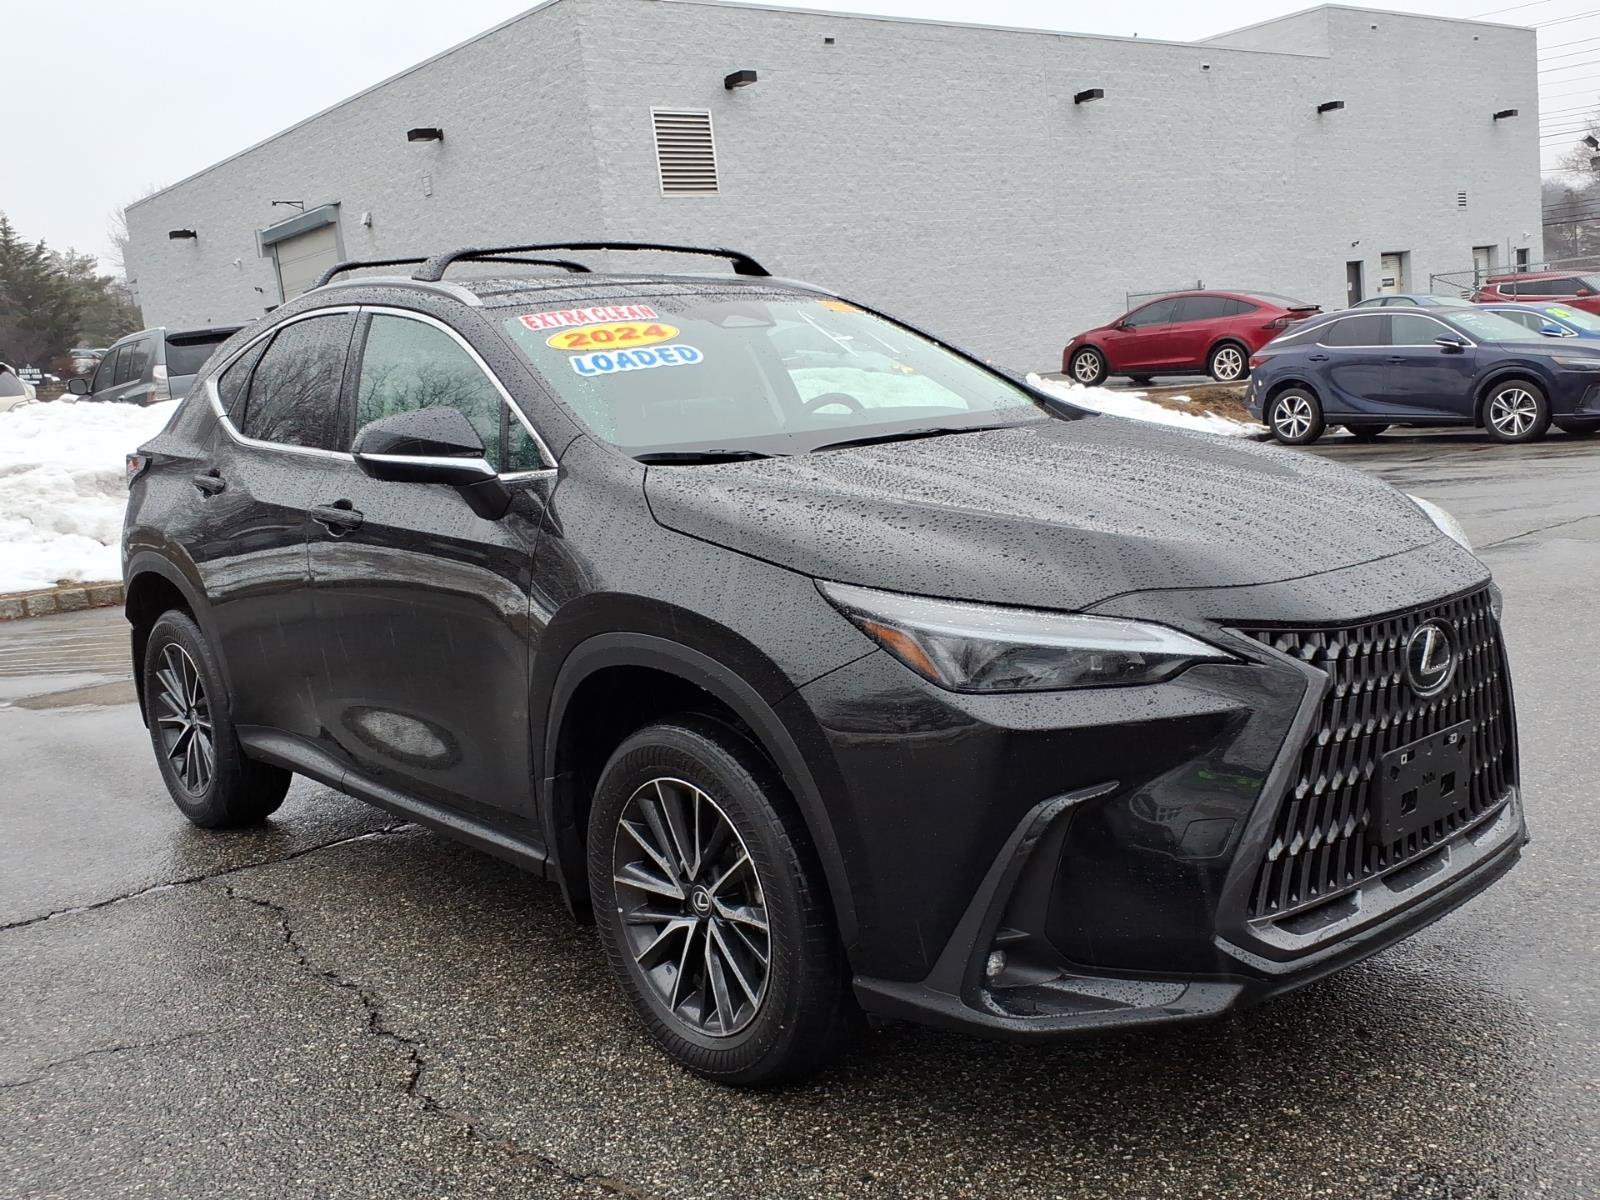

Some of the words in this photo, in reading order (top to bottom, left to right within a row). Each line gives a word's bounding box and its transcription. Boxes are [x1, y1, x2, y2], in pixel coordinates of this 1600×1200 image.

[521, 309, 593, 329] EXTRA
[591, 305, 657, 321] CLEAN
[564, 324, 669, 348] 2024
[573, 346, 699, 375] LOADED
